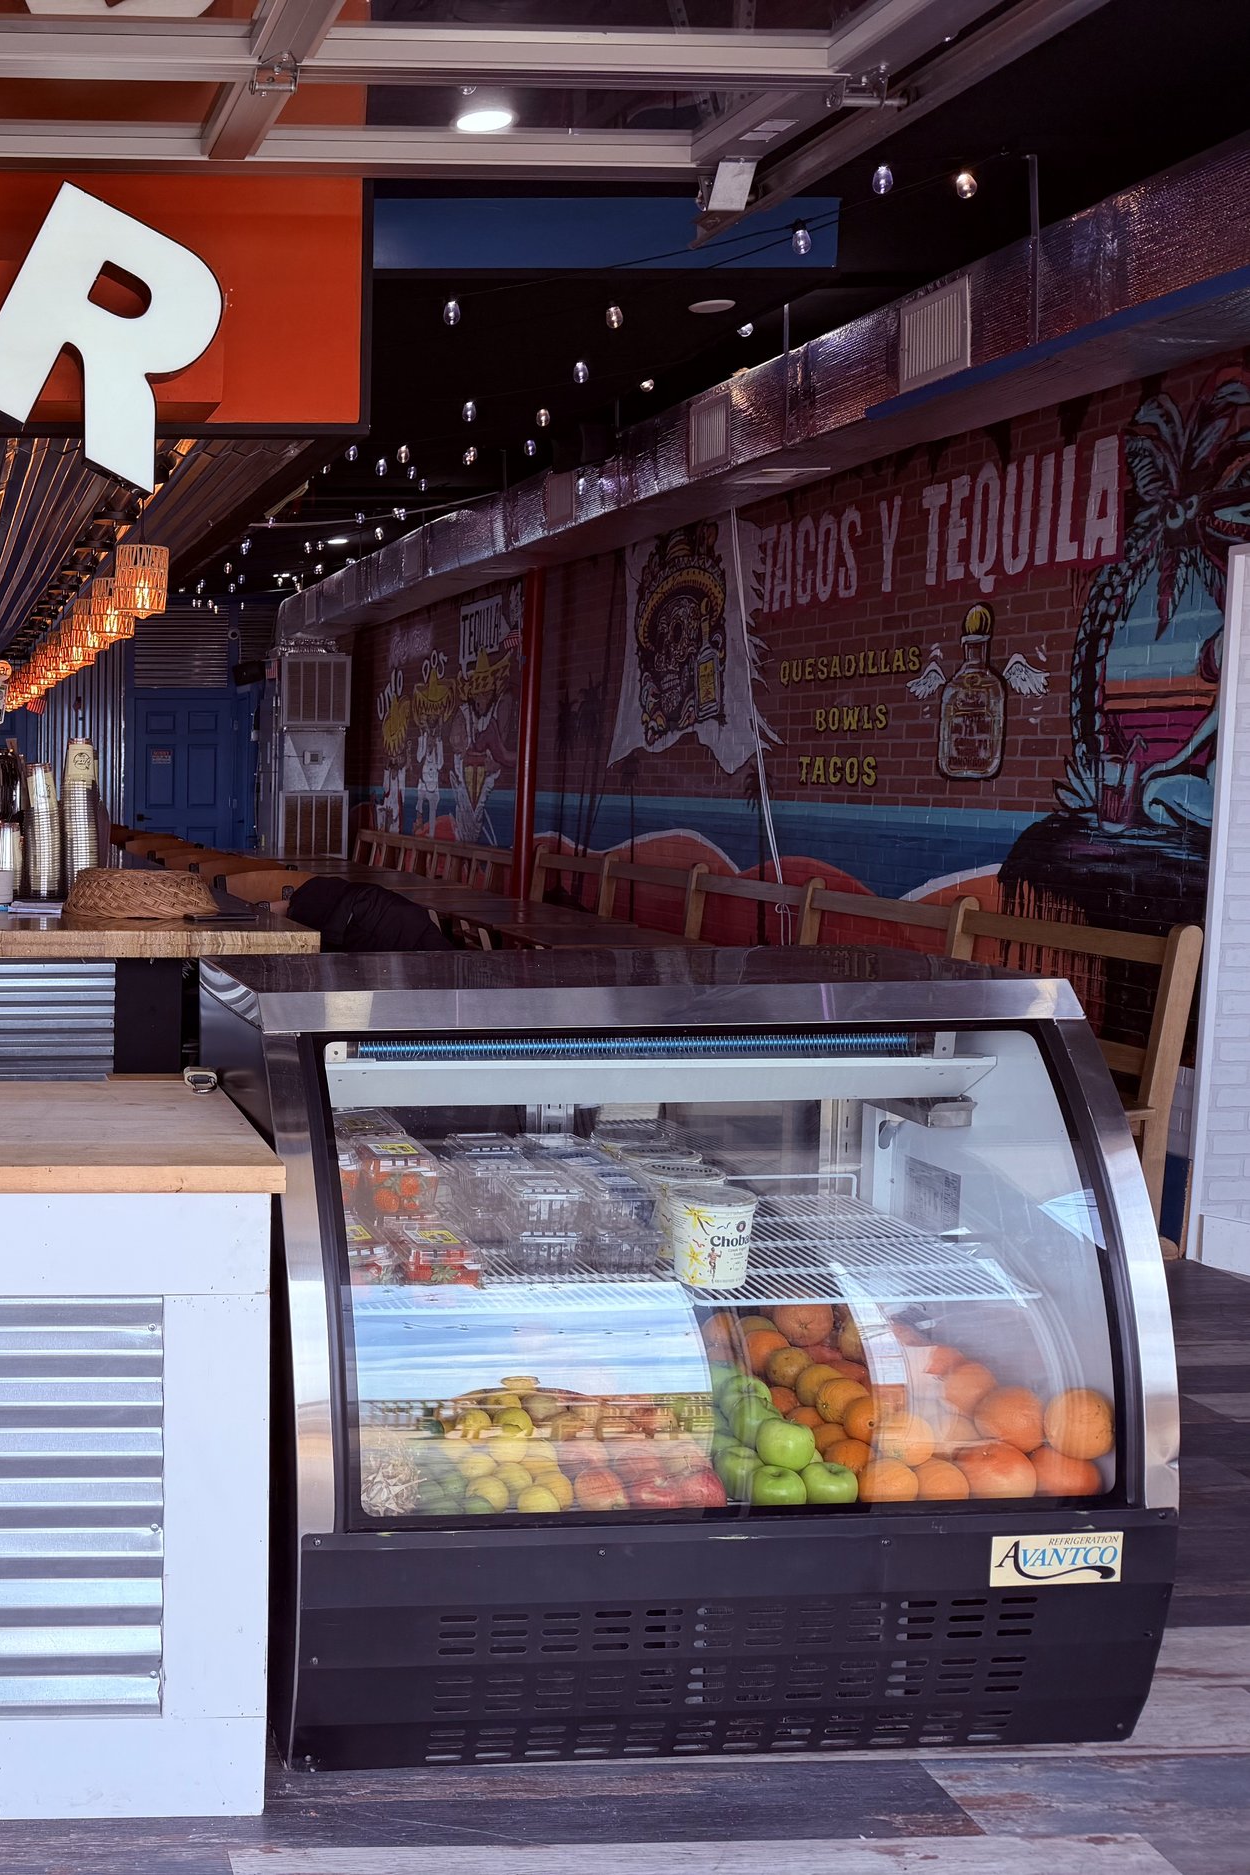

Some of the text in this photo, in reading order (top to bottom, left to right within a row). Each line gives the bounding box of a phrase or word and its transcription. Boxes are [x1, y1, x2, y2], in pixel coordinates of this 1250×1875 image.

[761, 434, 1120, 614] TACOS Y TEQUILA
[461, 602, 502, 661] TEQUILA
[421, 649, 448, 684] DOS
[779, 647, 923, 686] QUESADILLAS
[376, 668, 405, 721] UNO
[815, 704, 888, 734] BOWLS
[798, 756, 877, 787] TACOS
[994, 1540, 1119, 1568] AVANTCO
[1048, 1535, 1119, 1546] REFRIGERATION
